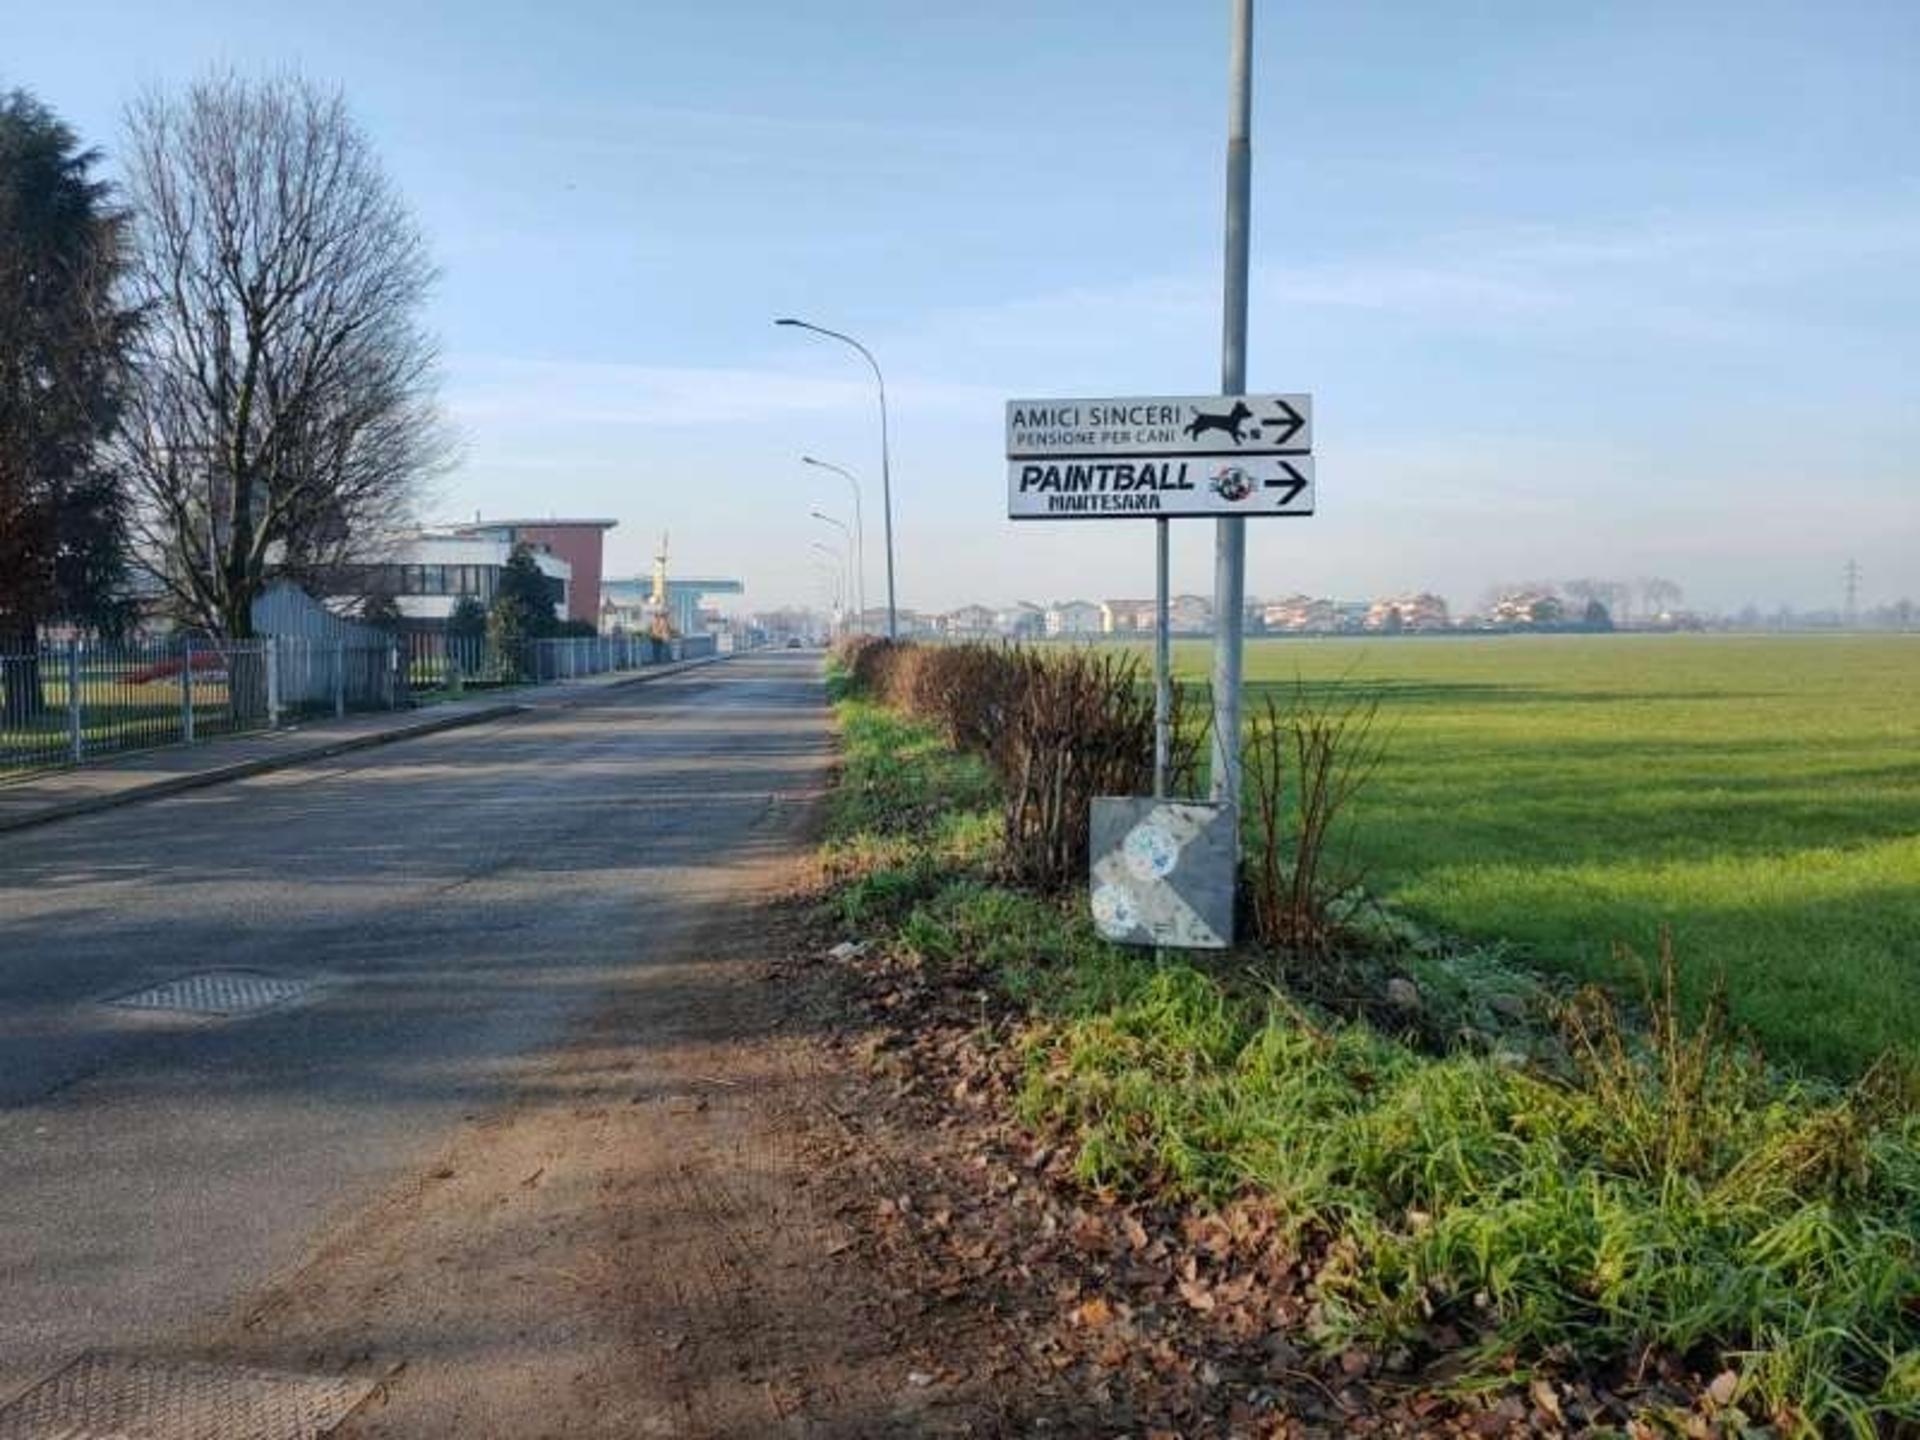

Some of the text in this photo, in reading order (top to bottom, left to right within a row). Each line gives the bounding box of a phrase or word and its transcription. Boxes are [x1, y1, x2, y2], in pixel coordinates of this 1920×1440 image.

[1012, 405, 1181, 428] AMICI SINCERI
[1017, 429, 1175, 446] PENSIONE PER CANI
[1019, 463, 1195, 492] PAINTBALL
